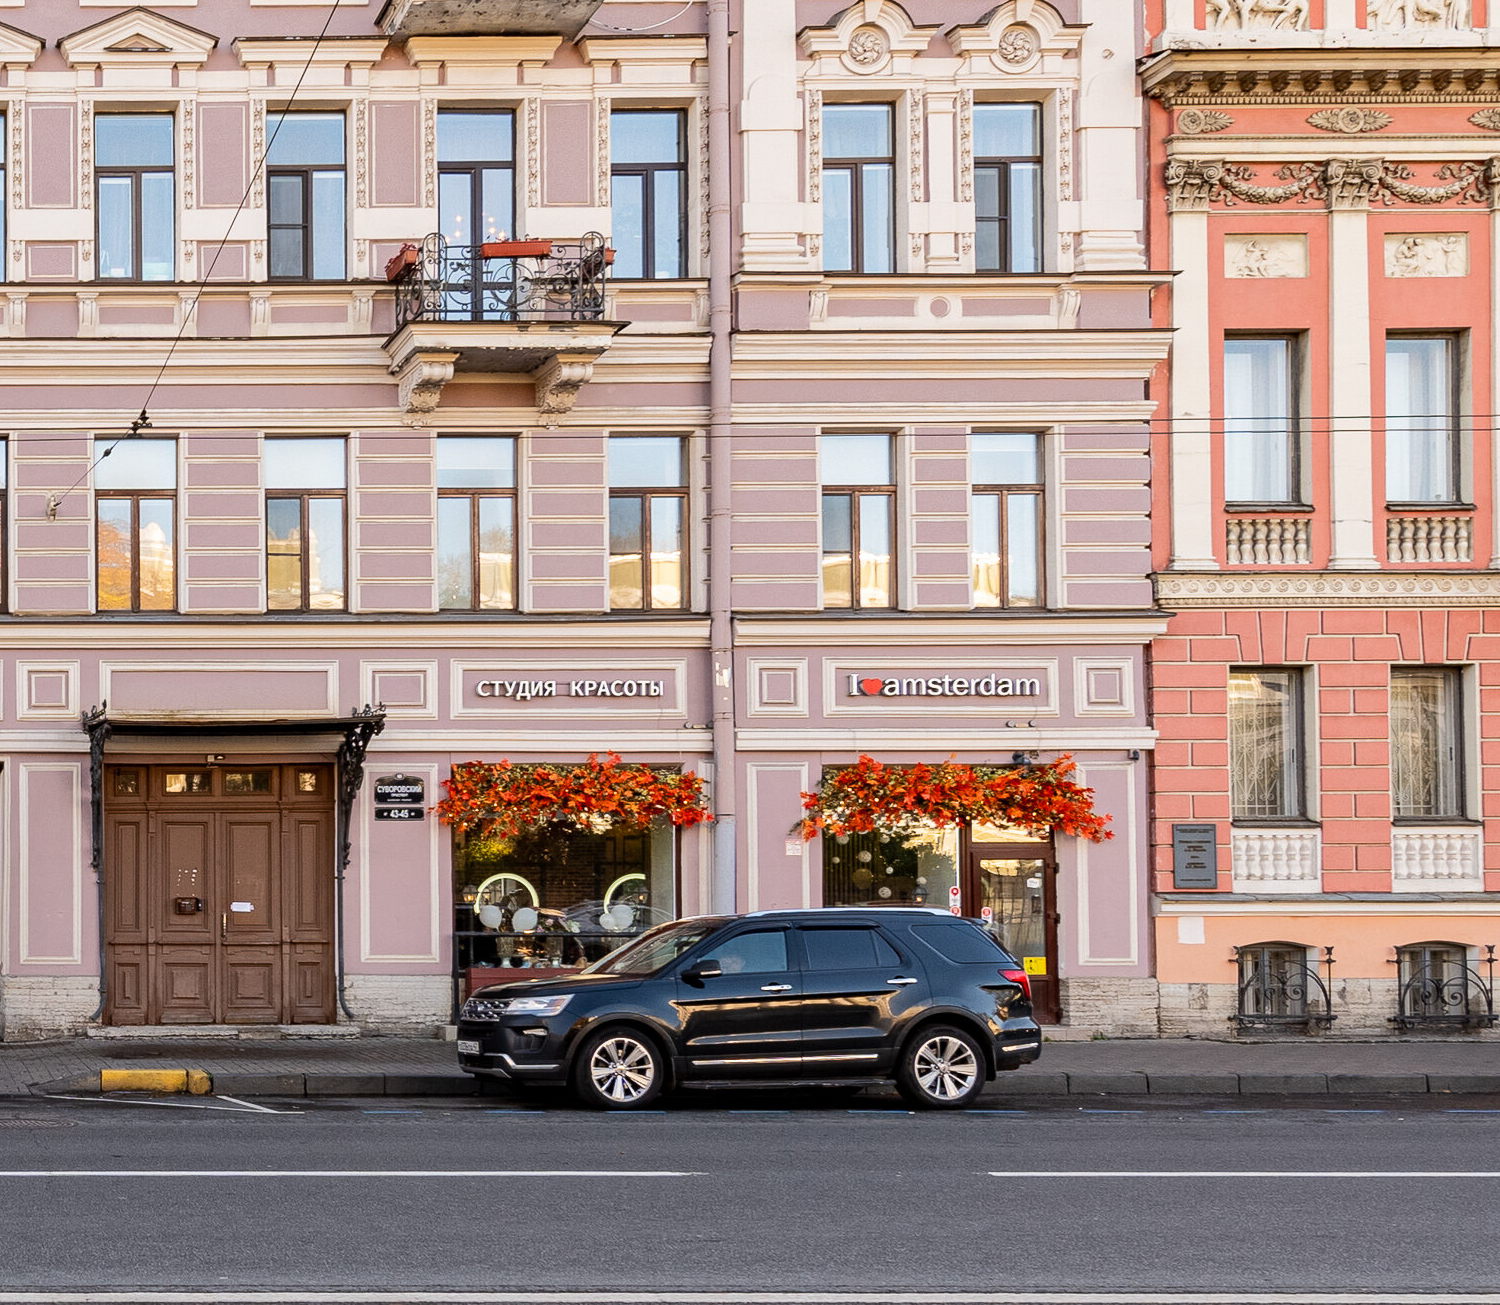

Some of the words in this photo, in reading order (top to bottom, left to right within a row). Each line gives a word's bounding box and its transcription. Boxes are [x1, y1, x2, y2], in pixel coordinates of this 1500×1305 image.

[476, 680, 557, 701] СТУДИЯ
[569, 680, 665, 697] КРАСОТЫ
[883, 673, 1041, 696] amsterdam
[377, 784, 422, 793] СУВОРОВСКИЙ
[390, 809, 409, 818] 43-45
